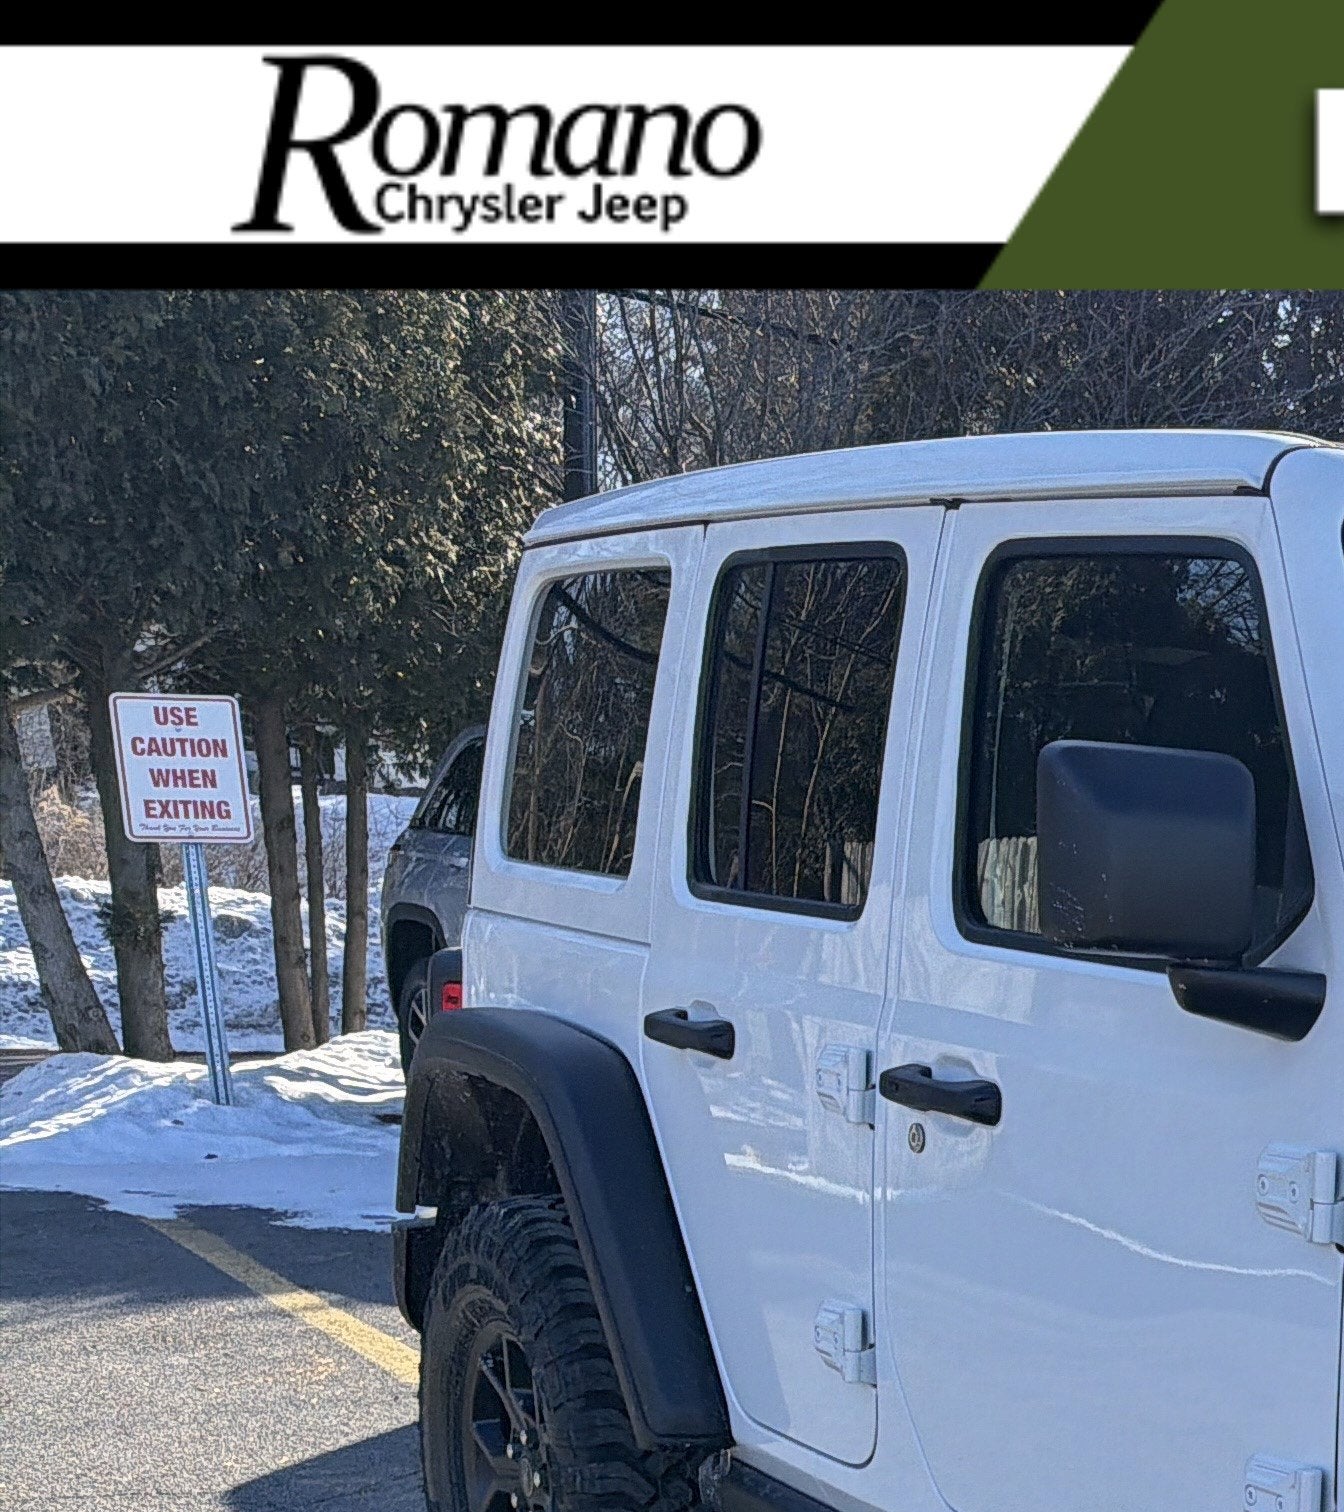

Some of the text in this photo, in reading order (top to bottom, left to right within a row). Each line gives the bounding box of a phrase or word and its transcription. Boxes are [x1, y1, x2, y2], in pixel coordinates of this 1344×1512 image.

[153, 705, 199, 727] USE
[130, 736, 229, 758] CAUTION
[149, 767, 218, 789] WHEN
[143, 799, 232, 820] EXITING
